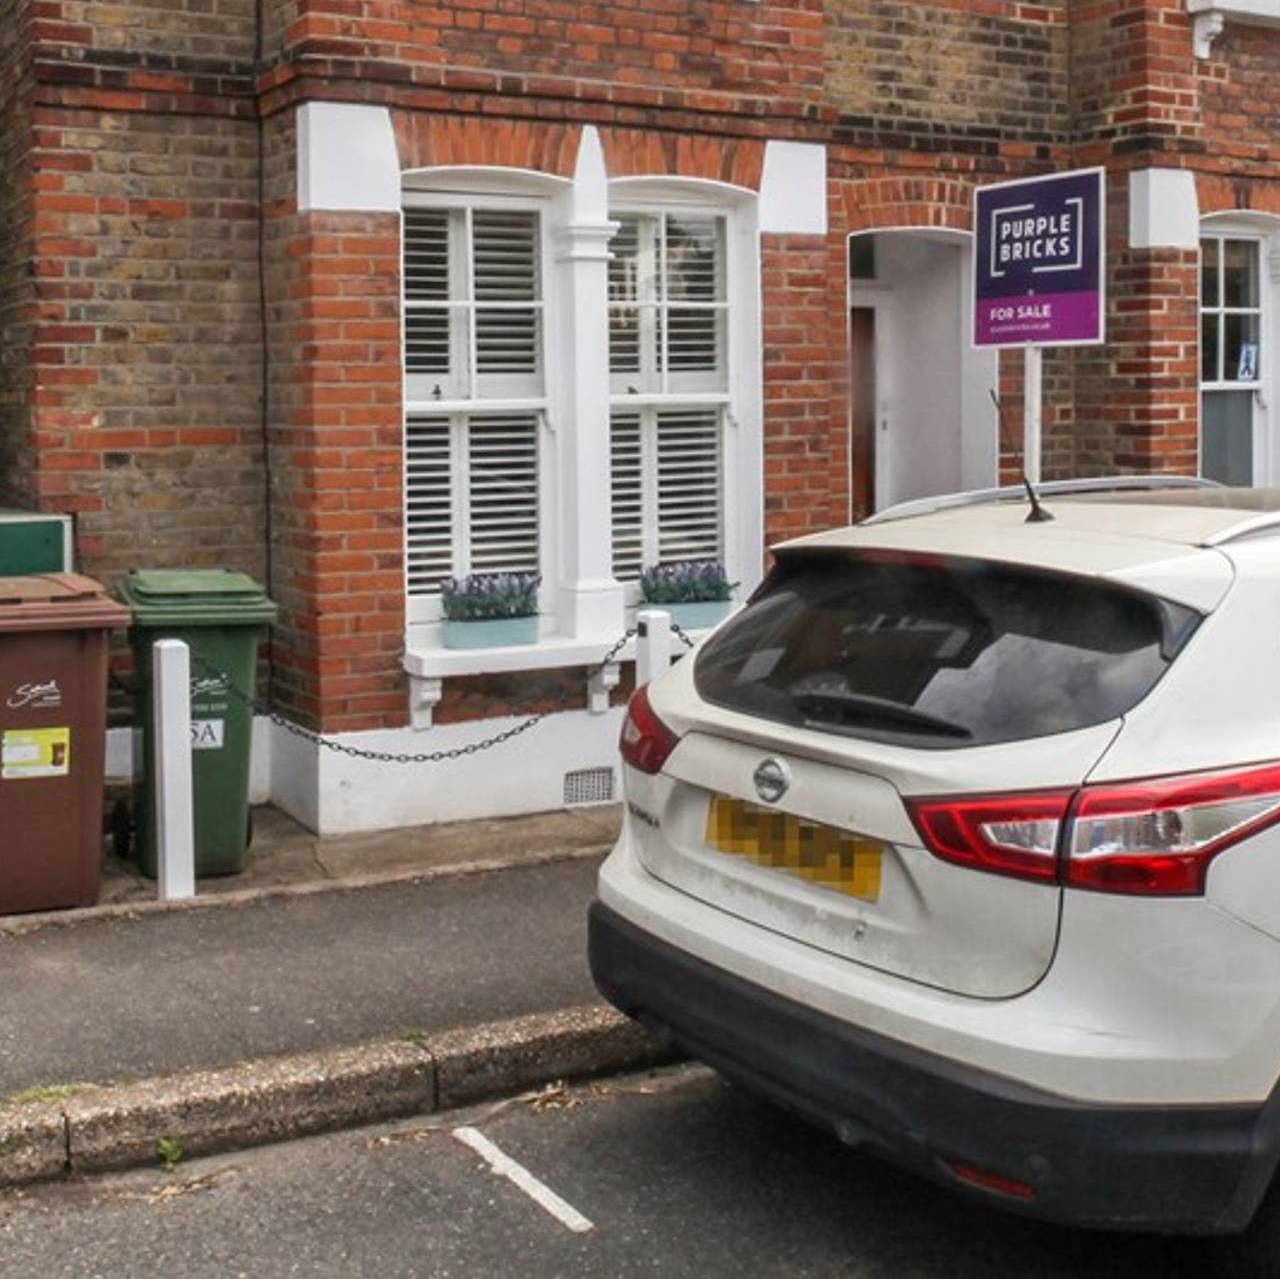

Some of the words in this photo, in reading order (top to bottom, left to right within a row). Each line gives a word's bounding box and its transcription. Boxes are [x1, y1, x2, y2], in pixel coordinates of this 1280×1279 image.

[1002, 214, 1071, 240] PURPLE
[1001, 236, 1070, 261] BRICKS
[990, 307, 1014, 321] FOR
[1017, 304, 1051, 318] SALE
